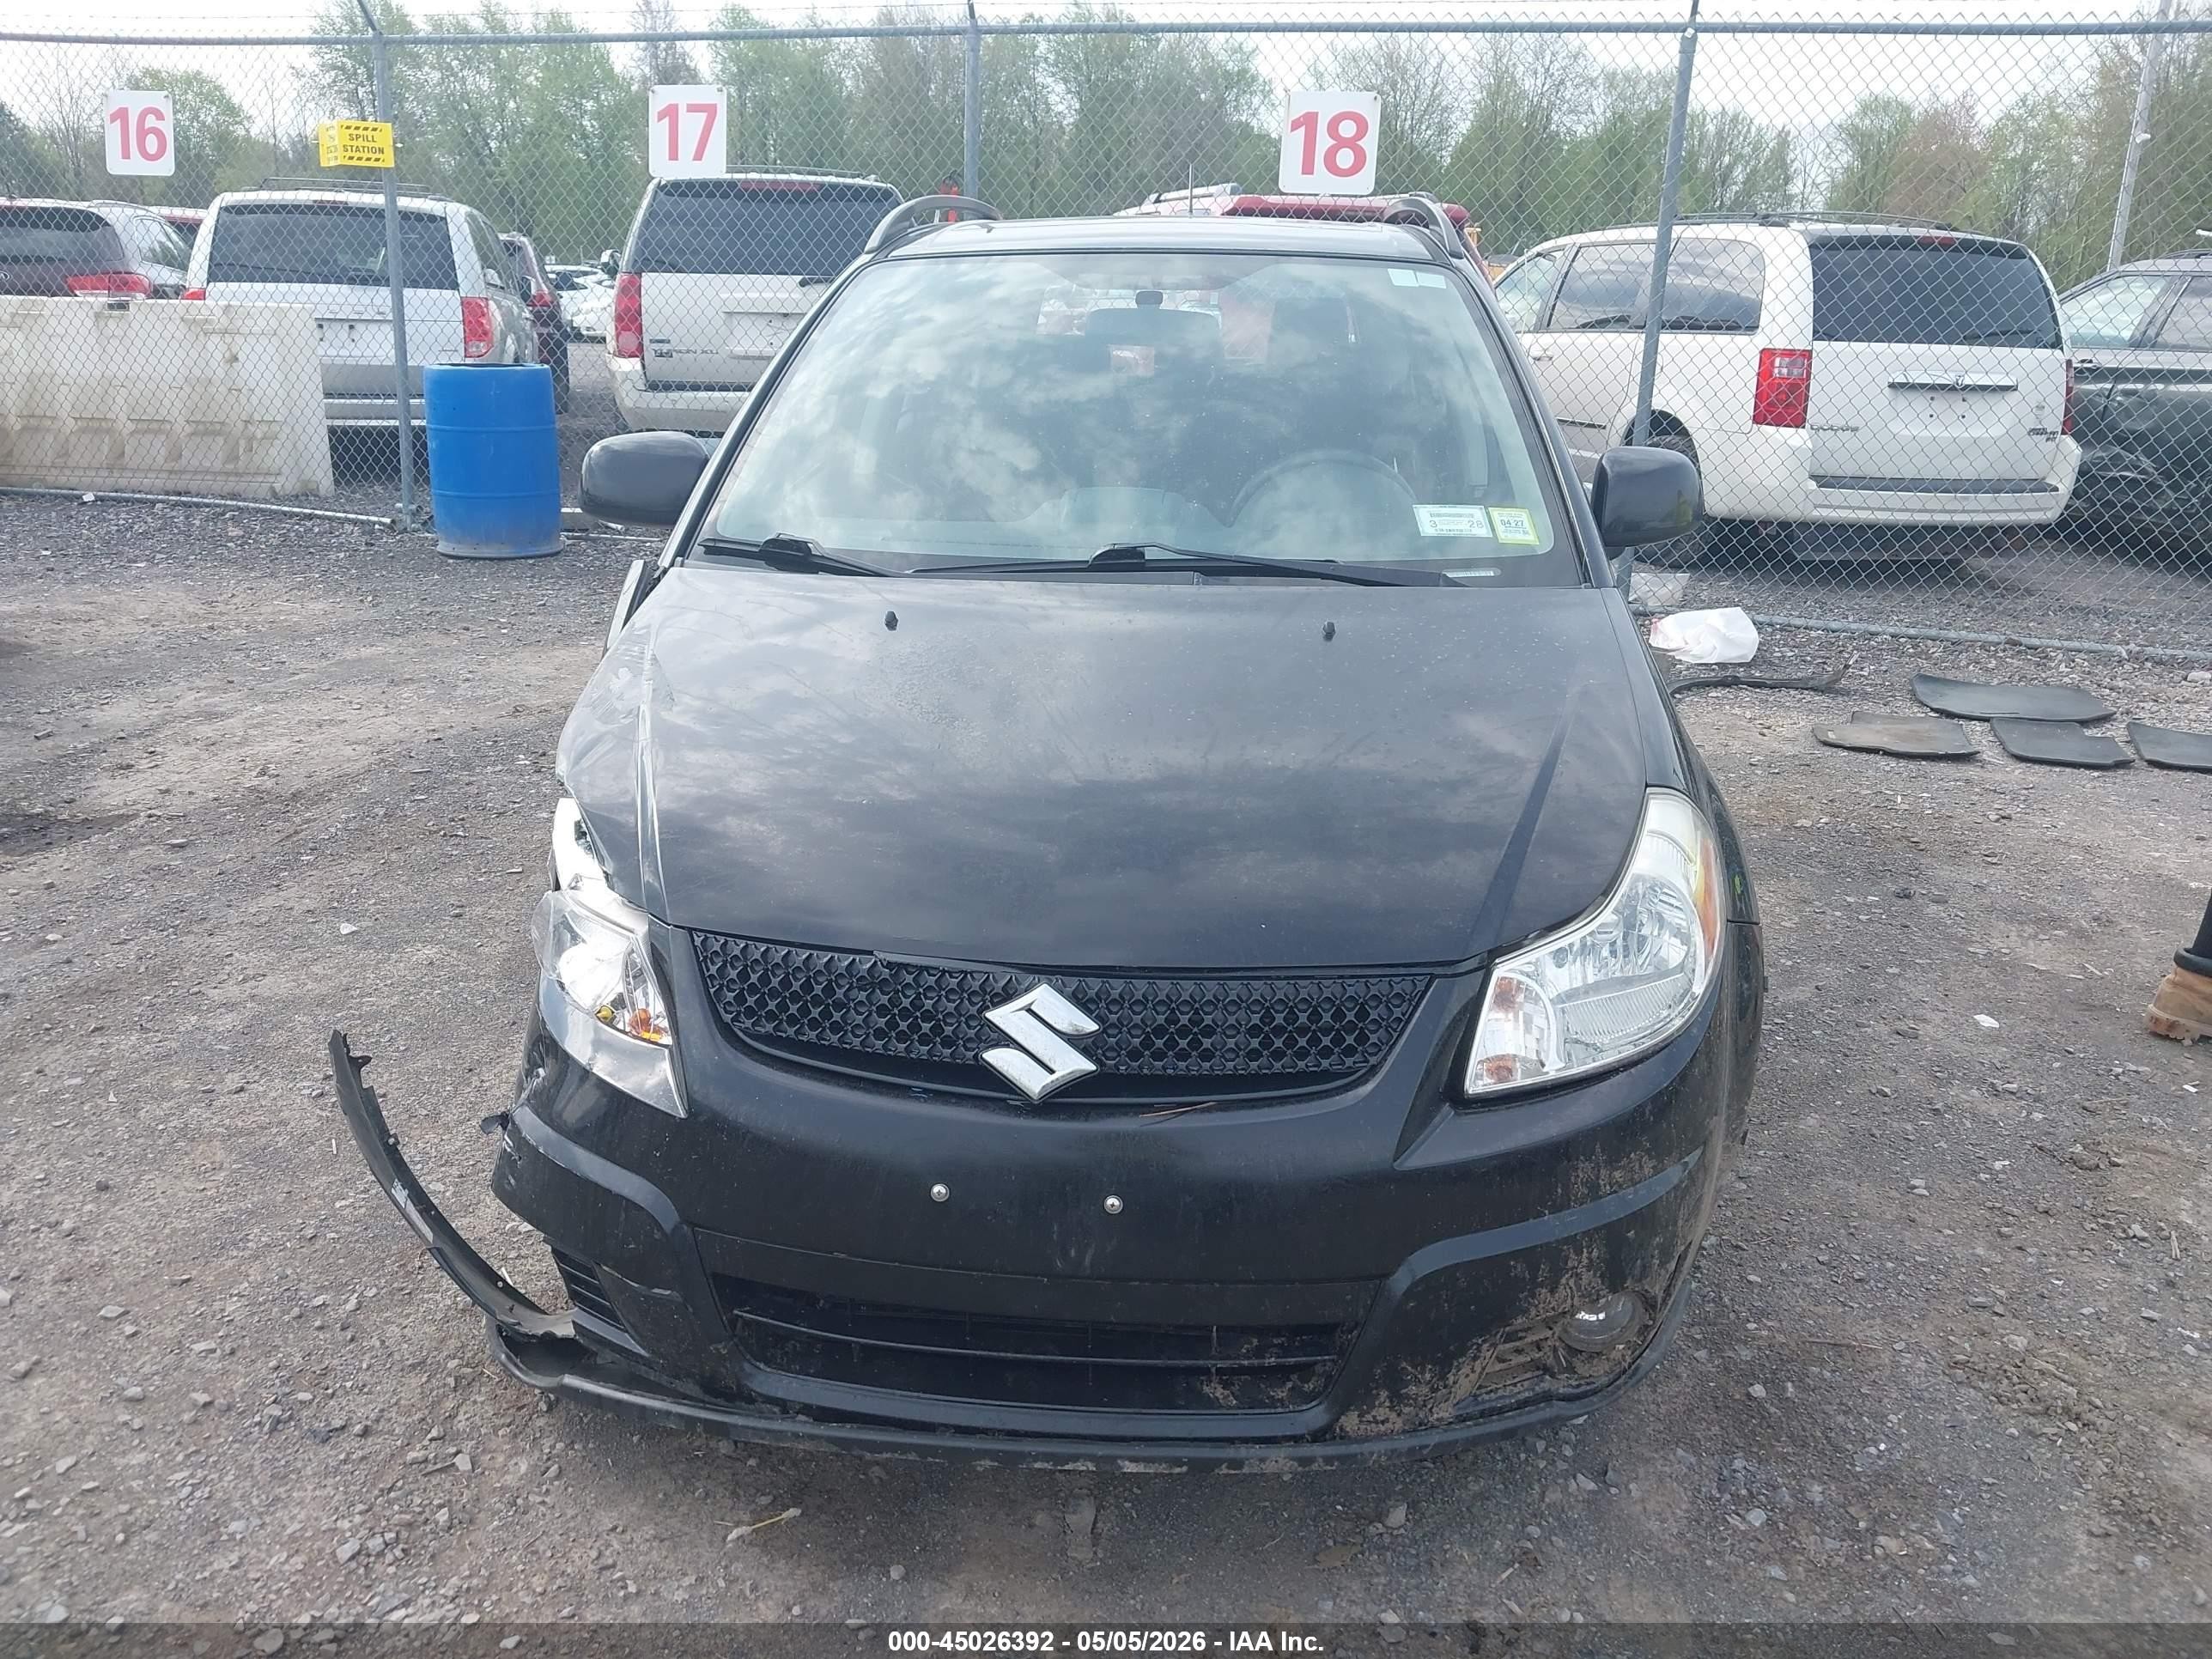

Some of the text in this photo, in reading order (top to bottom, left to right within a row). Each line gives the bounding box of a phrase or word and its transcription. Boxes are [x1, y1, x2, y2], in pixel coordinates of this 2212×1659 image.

[111, 107, 167, 161] 16
[343, 144, 385, 155] STATION
[348, 133, 377, 143] SPILL
[657, 103, 718, 161] 17
[1290, 111, 1370, 178] 18
